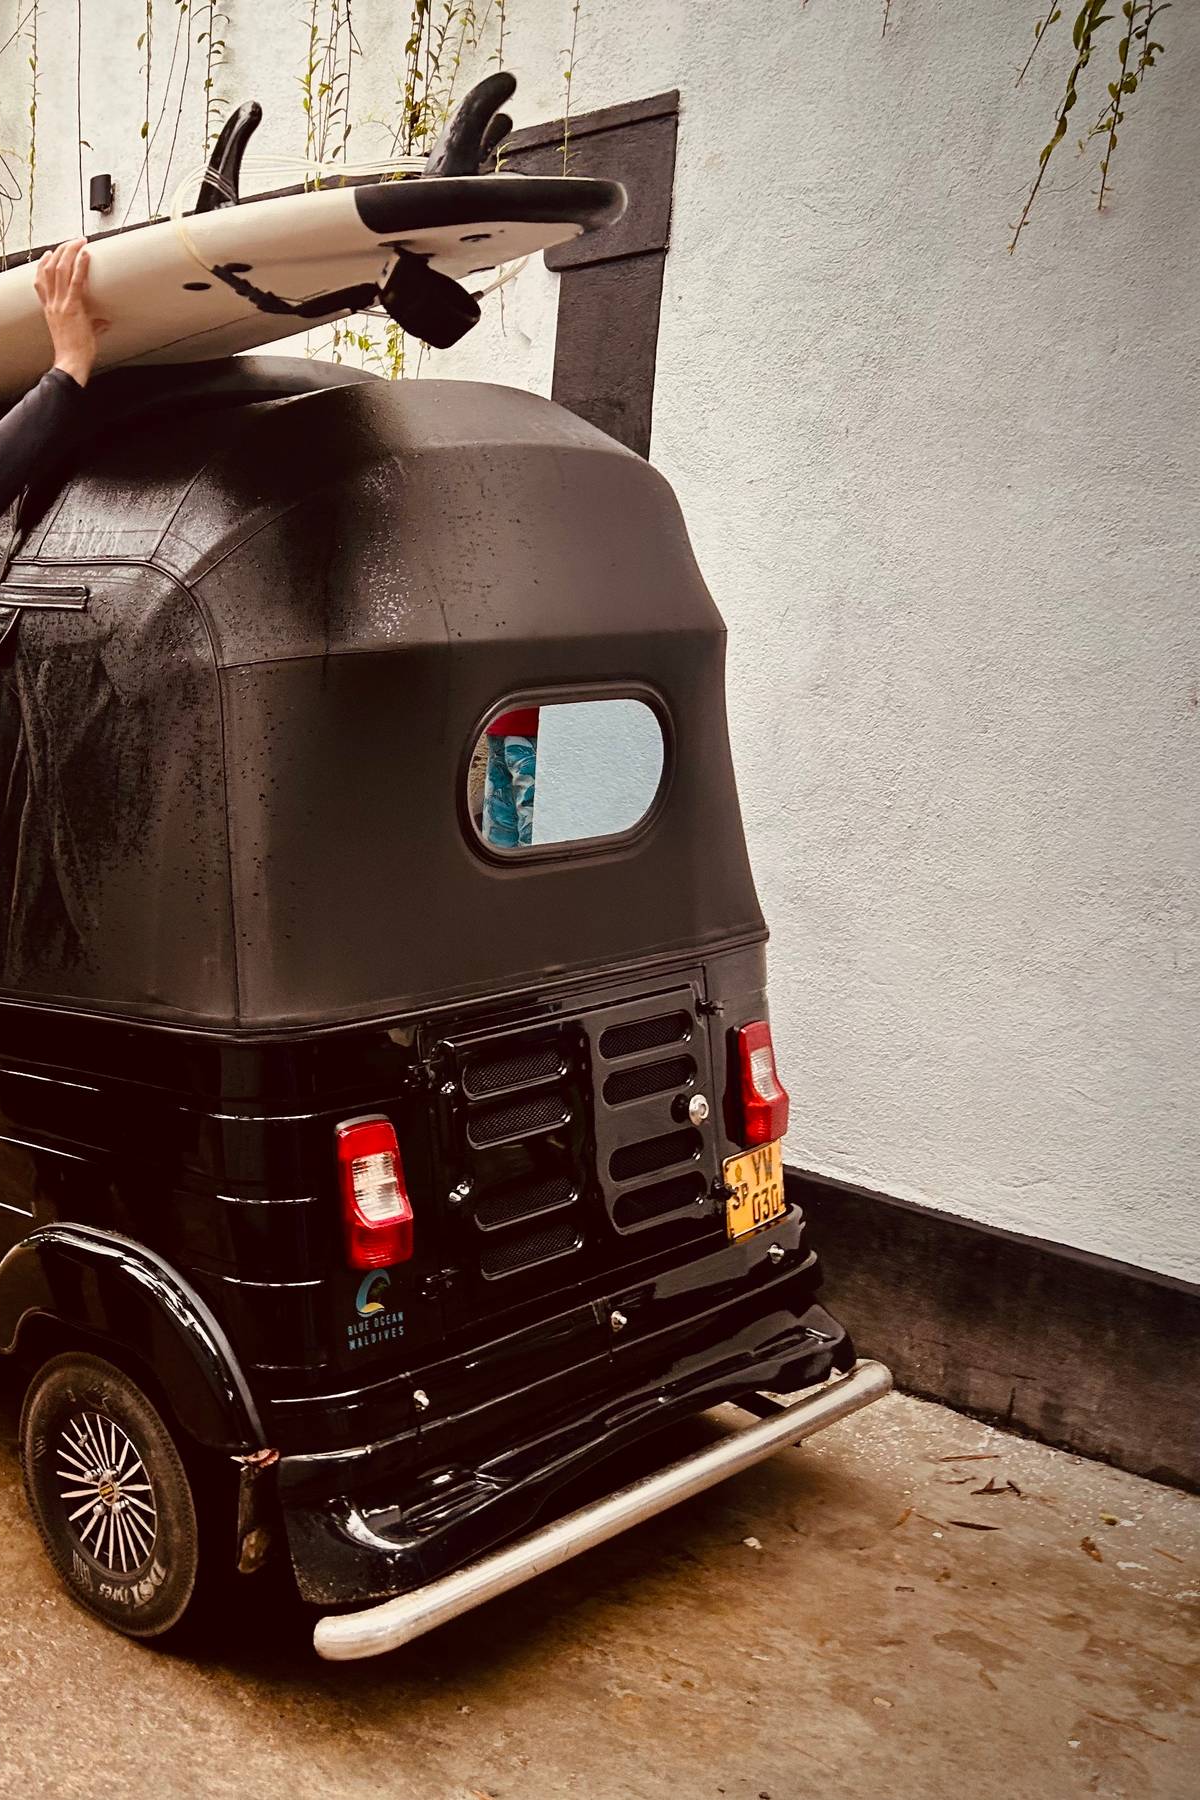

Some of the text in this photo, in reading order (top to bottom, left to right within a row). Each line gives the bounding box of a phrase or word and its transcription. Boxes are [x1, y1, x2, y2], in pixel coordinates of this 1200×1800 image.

[347, 1311, 404, 1336] BLUE OCEAN
[348, 1325, 404, 1351] MALDIVES
